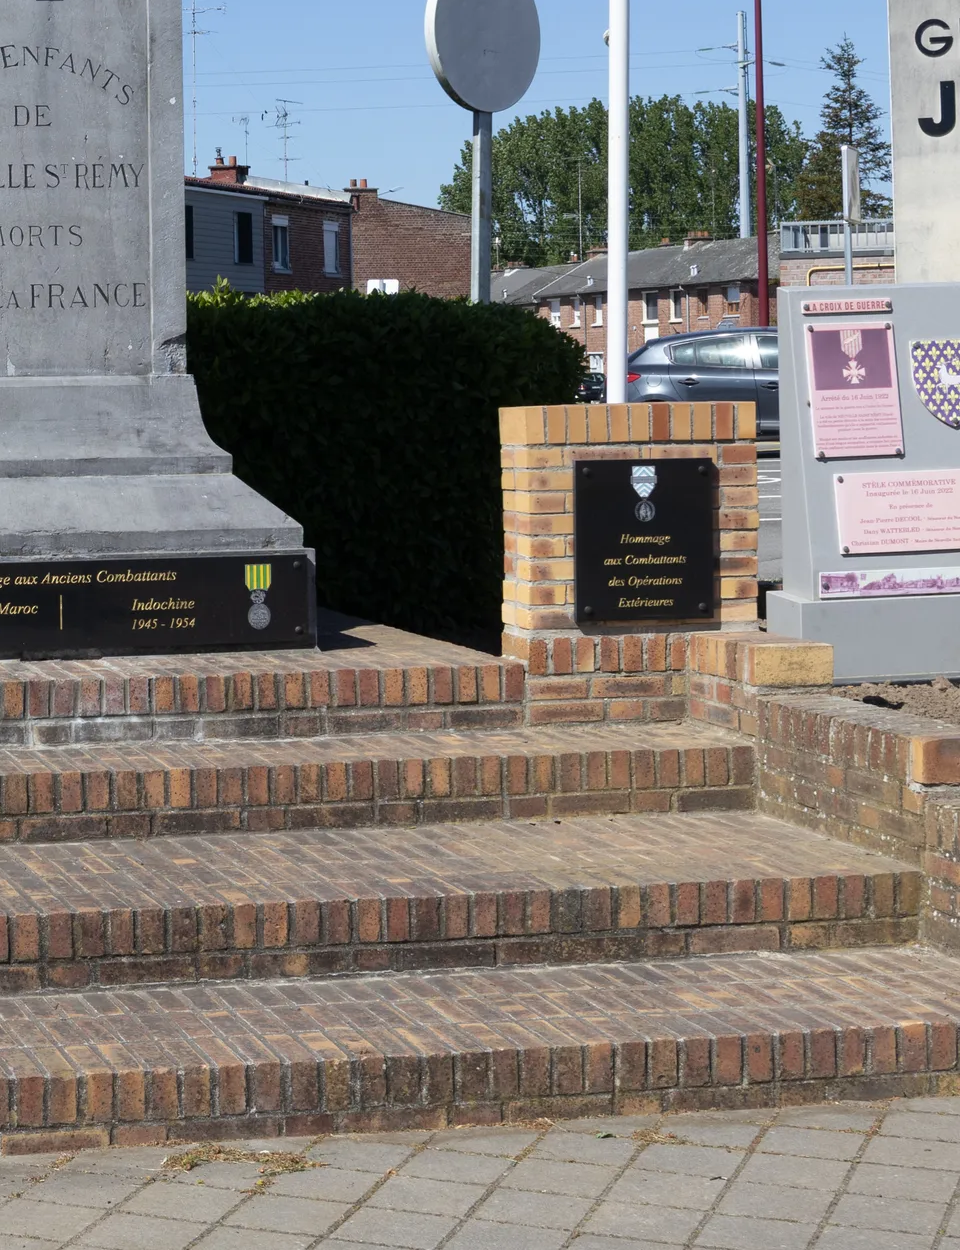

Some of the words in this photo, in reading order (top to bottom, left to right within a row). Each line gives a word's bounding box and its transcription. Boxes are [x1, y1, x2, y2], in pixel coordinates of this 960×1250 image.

[0, 44, 135, 106] ENFANTS
[13, 105, 51, 127] DE
[74, 155, 144, 190] RÉMY
[29, 283, 147, 309] FRANCE
[809, 304, 818, 312] LA
[820, 302, 843, 311] CROIX
[844, 302, 855, 310] DE
[856, 300, 885, 310] GUERRE
[888, 478, 956, 488] COMMÉMORATIVE
[620, 534, 671, 546] Hommage
[604, 558, 622, 566] aux
[624, 554, 687, 566] Combattants
[14, 576, 38, 585] aux
[41, 572, 92, 584] Anciens
[96, 570, 176, 583] Combattants
[608, 577, 624, 586] des
[628, 576, 682, 588] Opérations
[132, 598, 194, 611] Indochine
[618, 598, 674, 608] Extérieures
[132, 618, 158, 630] 1945
[170, 618, 196, 629] 1954
